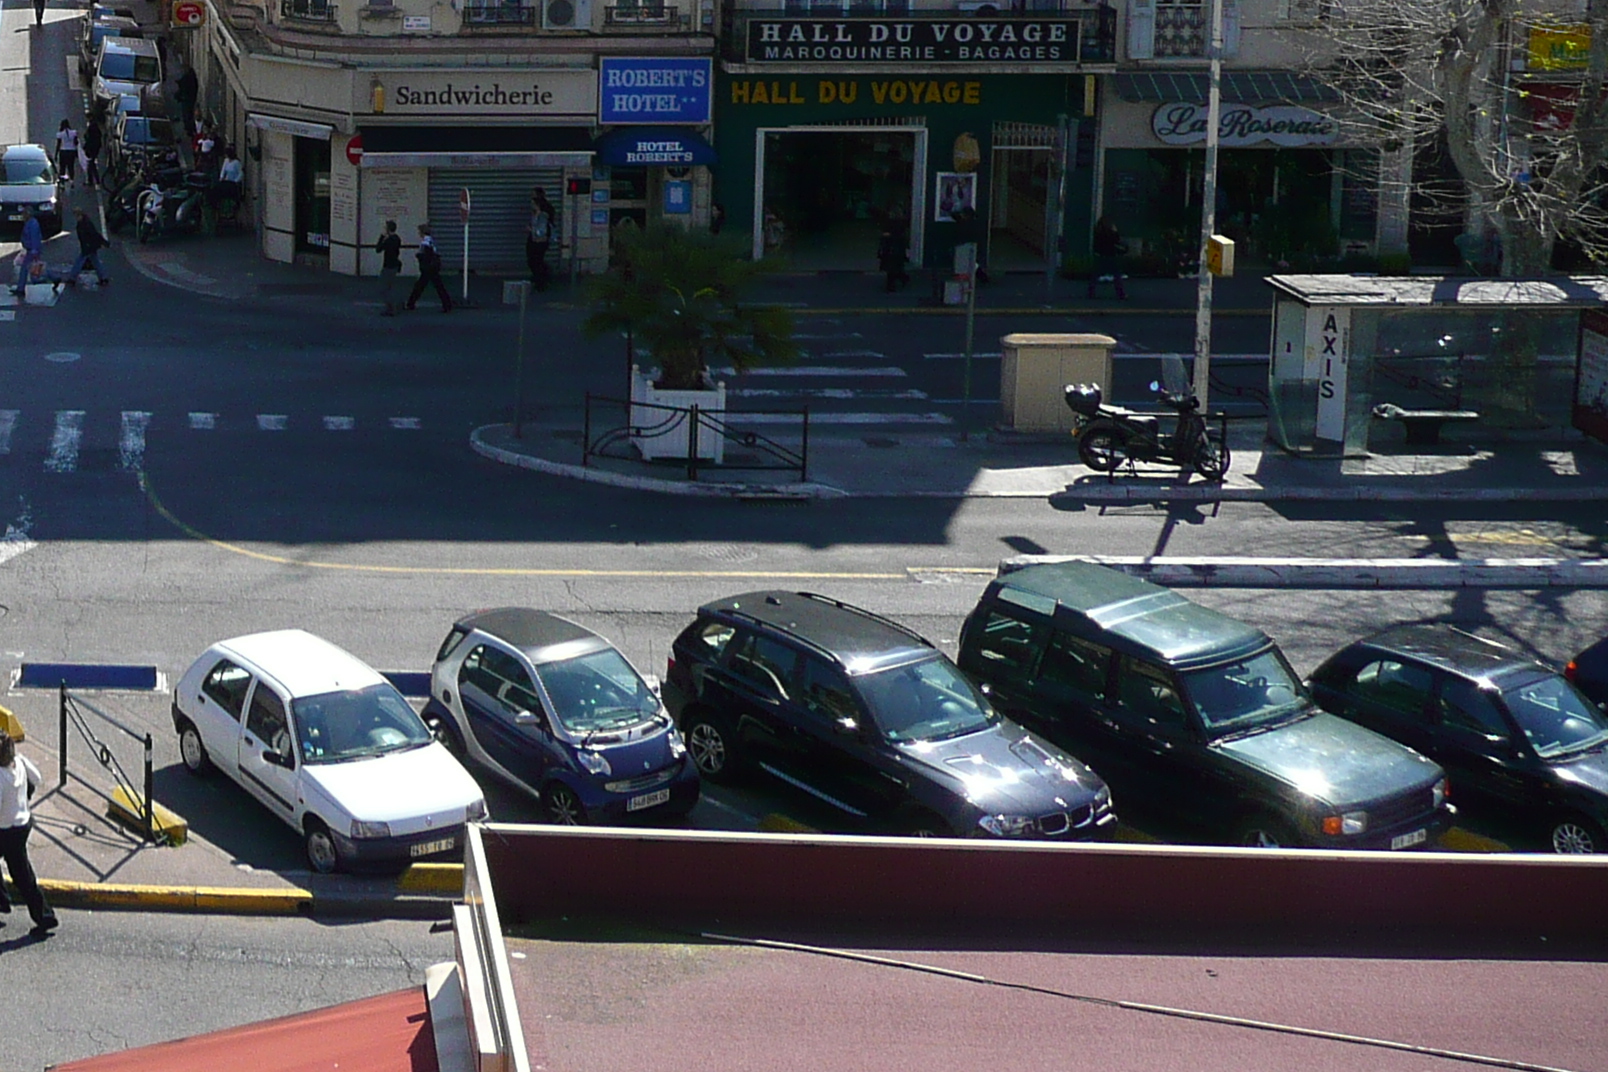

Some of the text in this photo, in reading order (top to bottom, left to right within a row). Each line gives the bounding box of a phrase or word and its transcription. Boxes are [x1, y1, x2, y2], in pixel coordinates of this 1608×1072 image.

[760, 24, 1069, 43] HALL DU VOYAGE
[764, 46, 936, 60] MAROQUINERIE
[958, 46, 1062, 59] BAGAGES
[607, 68, 706, 88] ROBERT'S
[395, 84, 553, 106] Sandwicherie
[730, 81, 982, 105] HALL DU VOYAGE
[1158, 106, 1334, 138] La Roseraie
[636, 141, 684, 152] HOTEL
[626, 152, 694, 163] ROBERT'S
[1320, 308, 1338, 399] AXIS
